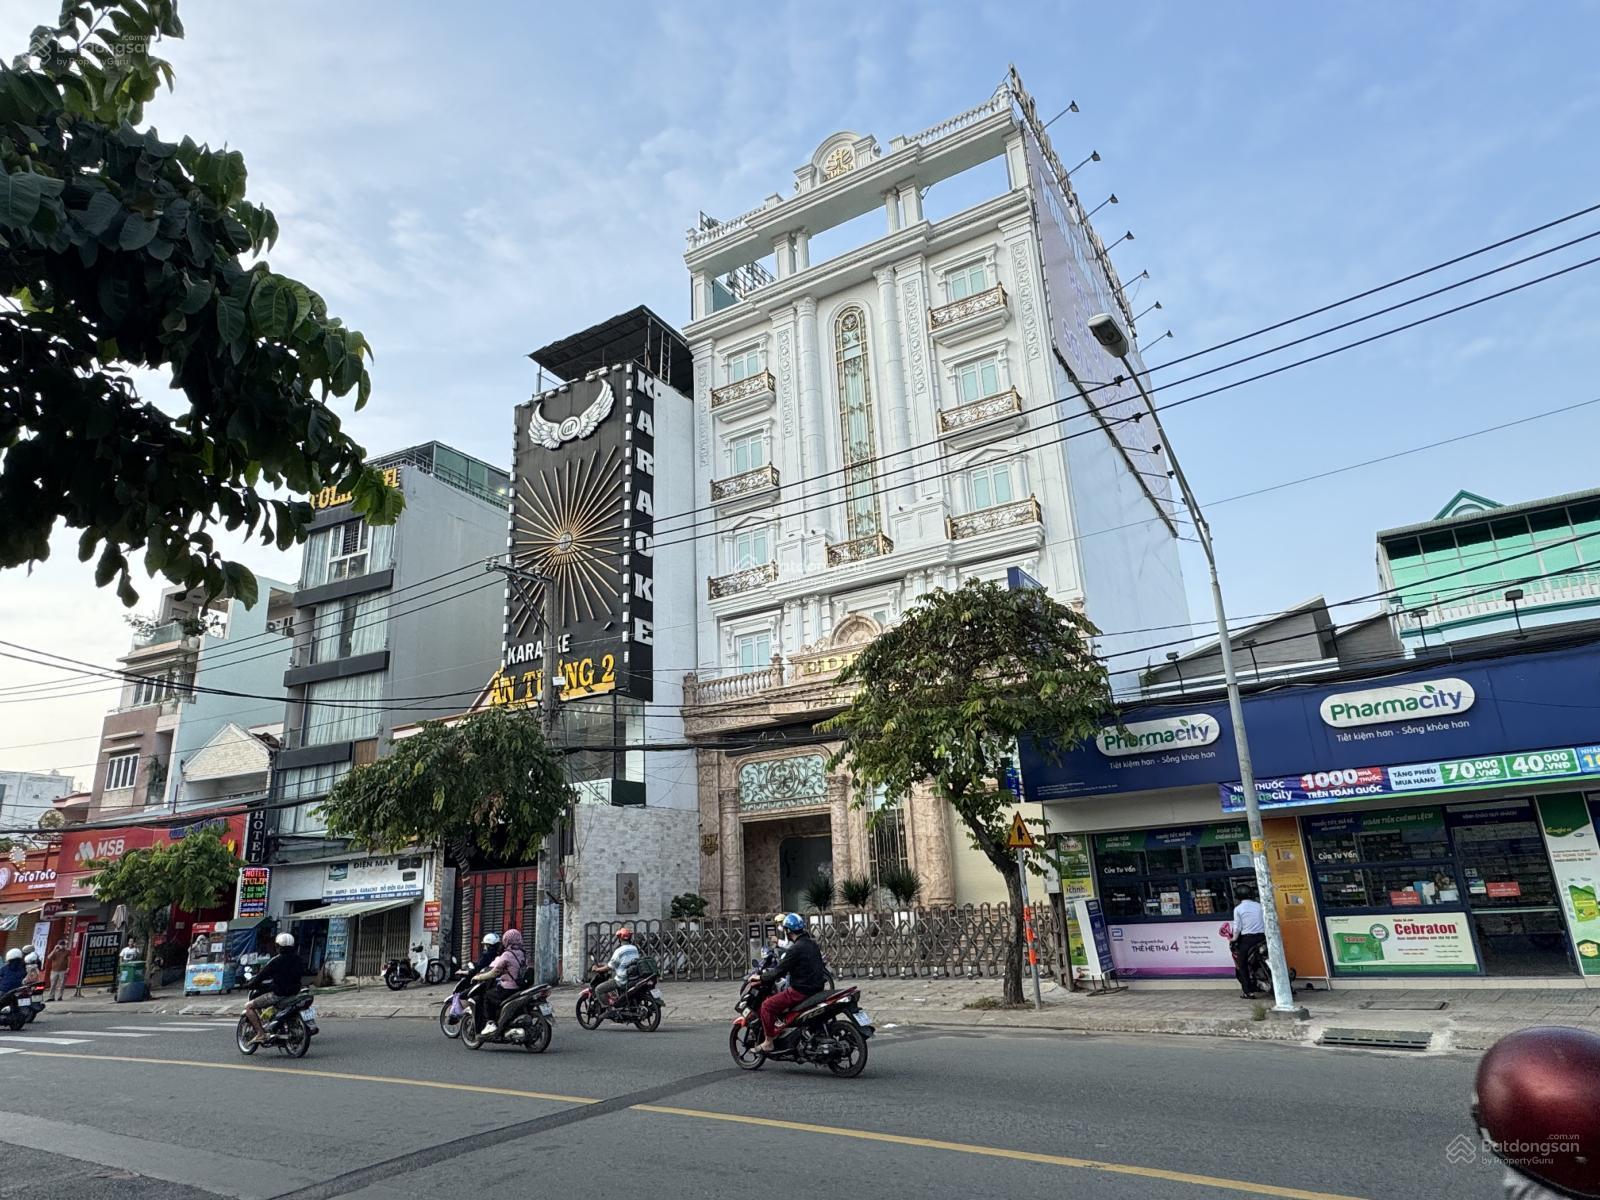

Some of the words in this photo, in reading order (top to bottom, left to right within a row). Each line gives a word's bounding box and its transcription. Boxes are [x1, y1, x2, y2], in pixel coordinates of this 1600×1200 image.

[633, 367, 654, 647] KARAOKE
[507, 633, 571, 665] KARAE
[602, 654, 616, 683] 2
[1330, 690, 1462, 720] Pharmacity
[1104, 723, 1209, 750] Pharmacity
[1354, 731, 1374, 741] kiệm
[1475, 759, 1498, 769] 000
[1513, 755, 1544, 773] 40
[1543, 752, 1568, 763] 000
[1302, 769, 1358, 788] 1000
[1444, 762, 1475, 780] 70
[1255, 780, 1286, 791] THUỐC
[1306, 789, 1328, 799] TRÊN
[1329, 786, 1355, 796] TOÀN
[1356, 783, 1383, 793] QUỐC
[250, 810, 264, 863] HOTEL
[96, 839, 125, 857] MSB
[1394, 923, 1457, 935] Cebraton
[89, 935, 119, 948] HOTEL
[1170, 940, 1180, 952] 4
